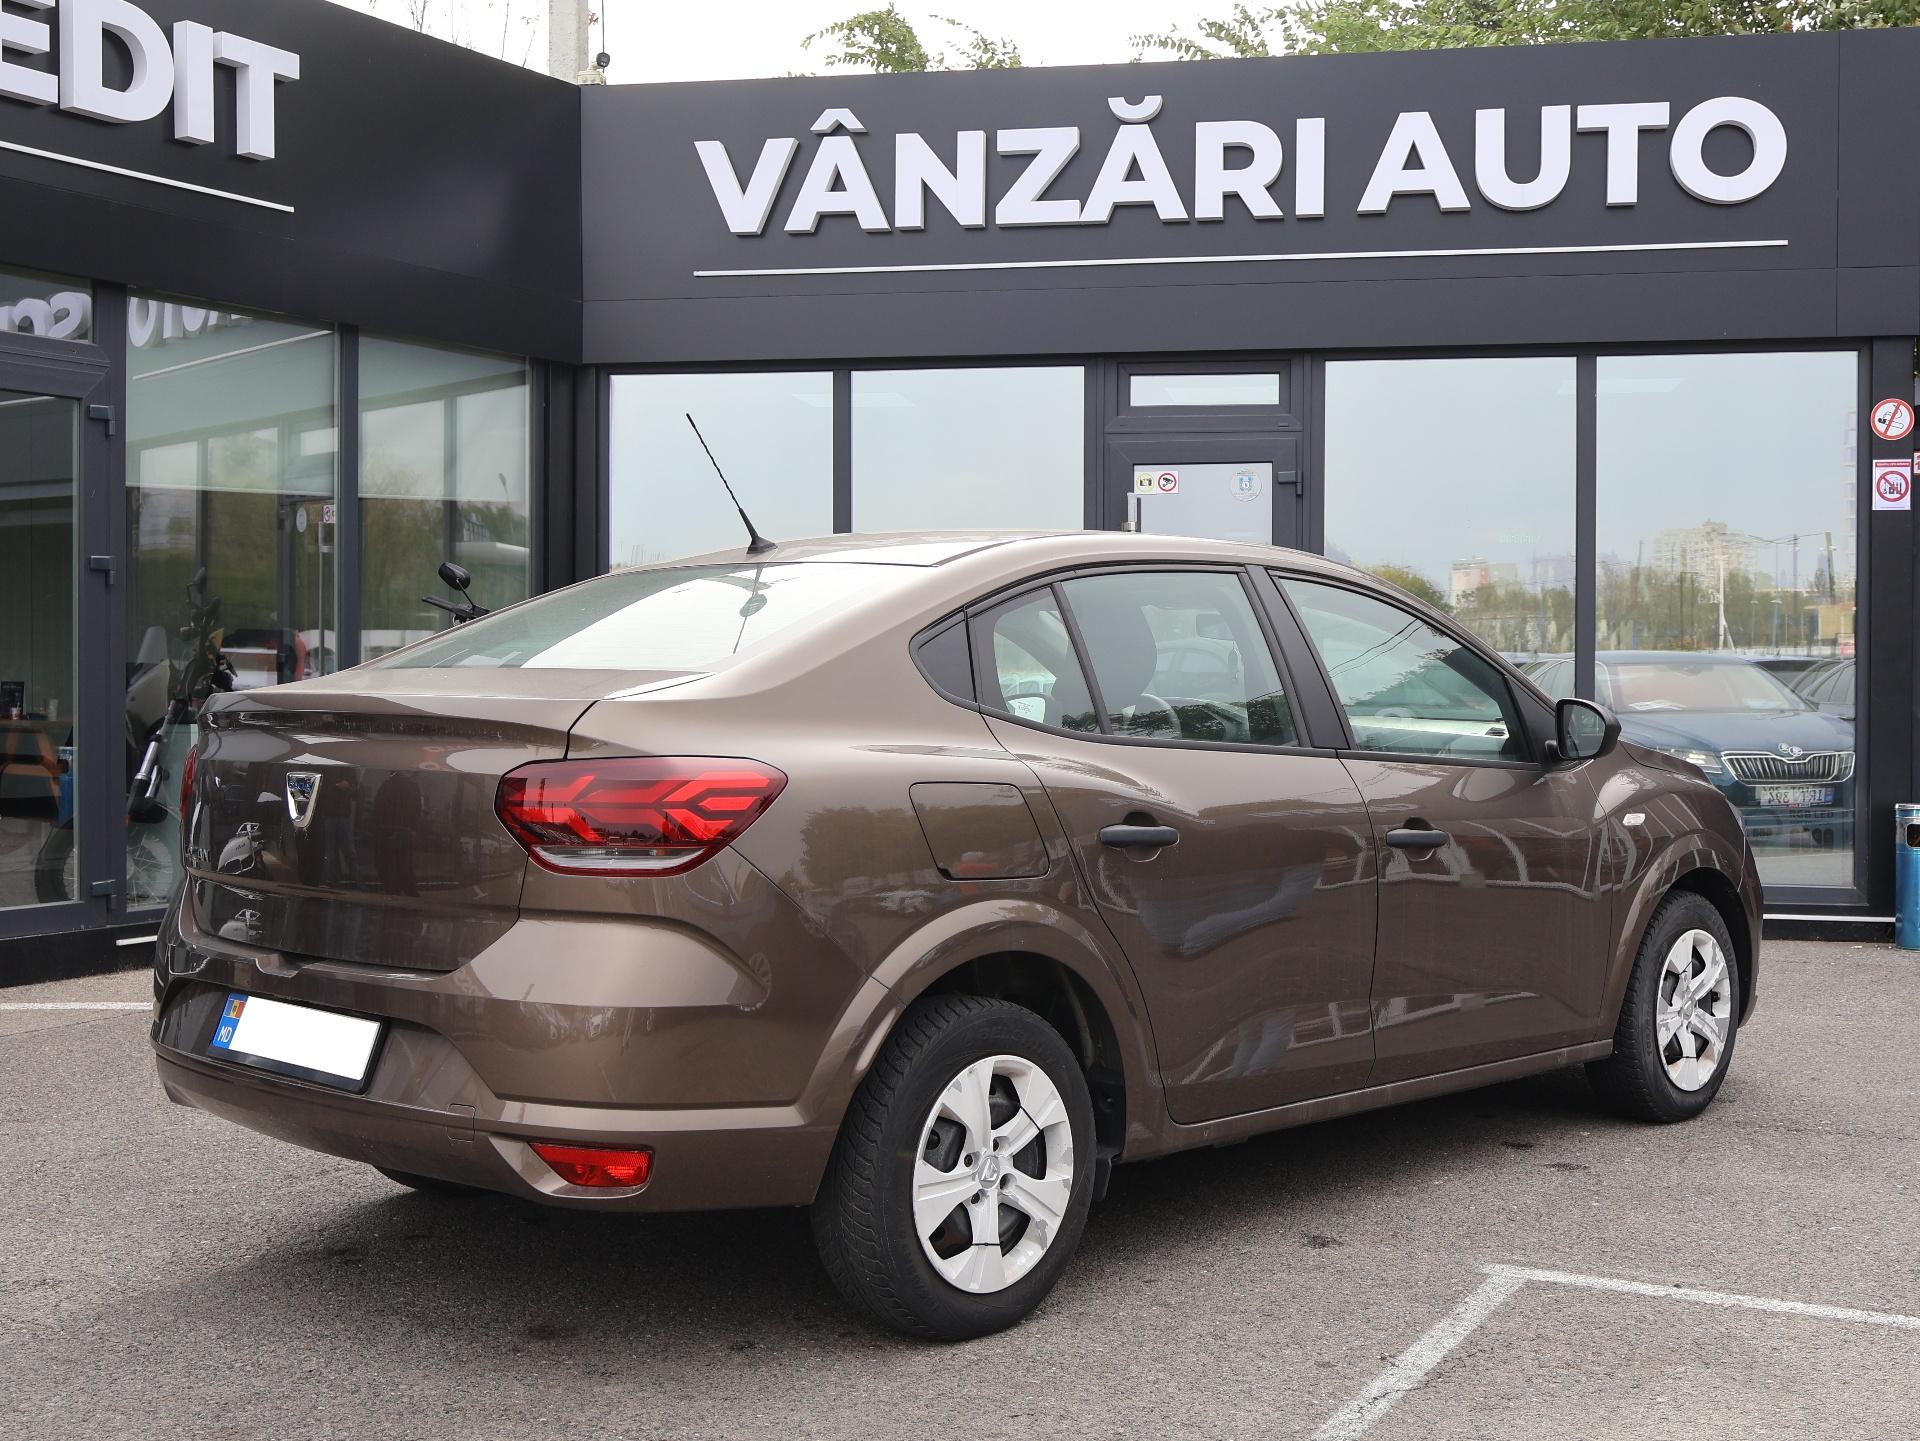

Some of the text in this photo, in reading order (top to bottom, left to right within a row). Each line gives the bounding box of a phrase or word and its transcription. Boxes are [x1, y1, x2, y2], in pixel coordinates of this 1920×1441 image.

[693, 95, 1788, 236] VÂNZĂRI AUTO
[217, 1026, 233, 1043] MD
